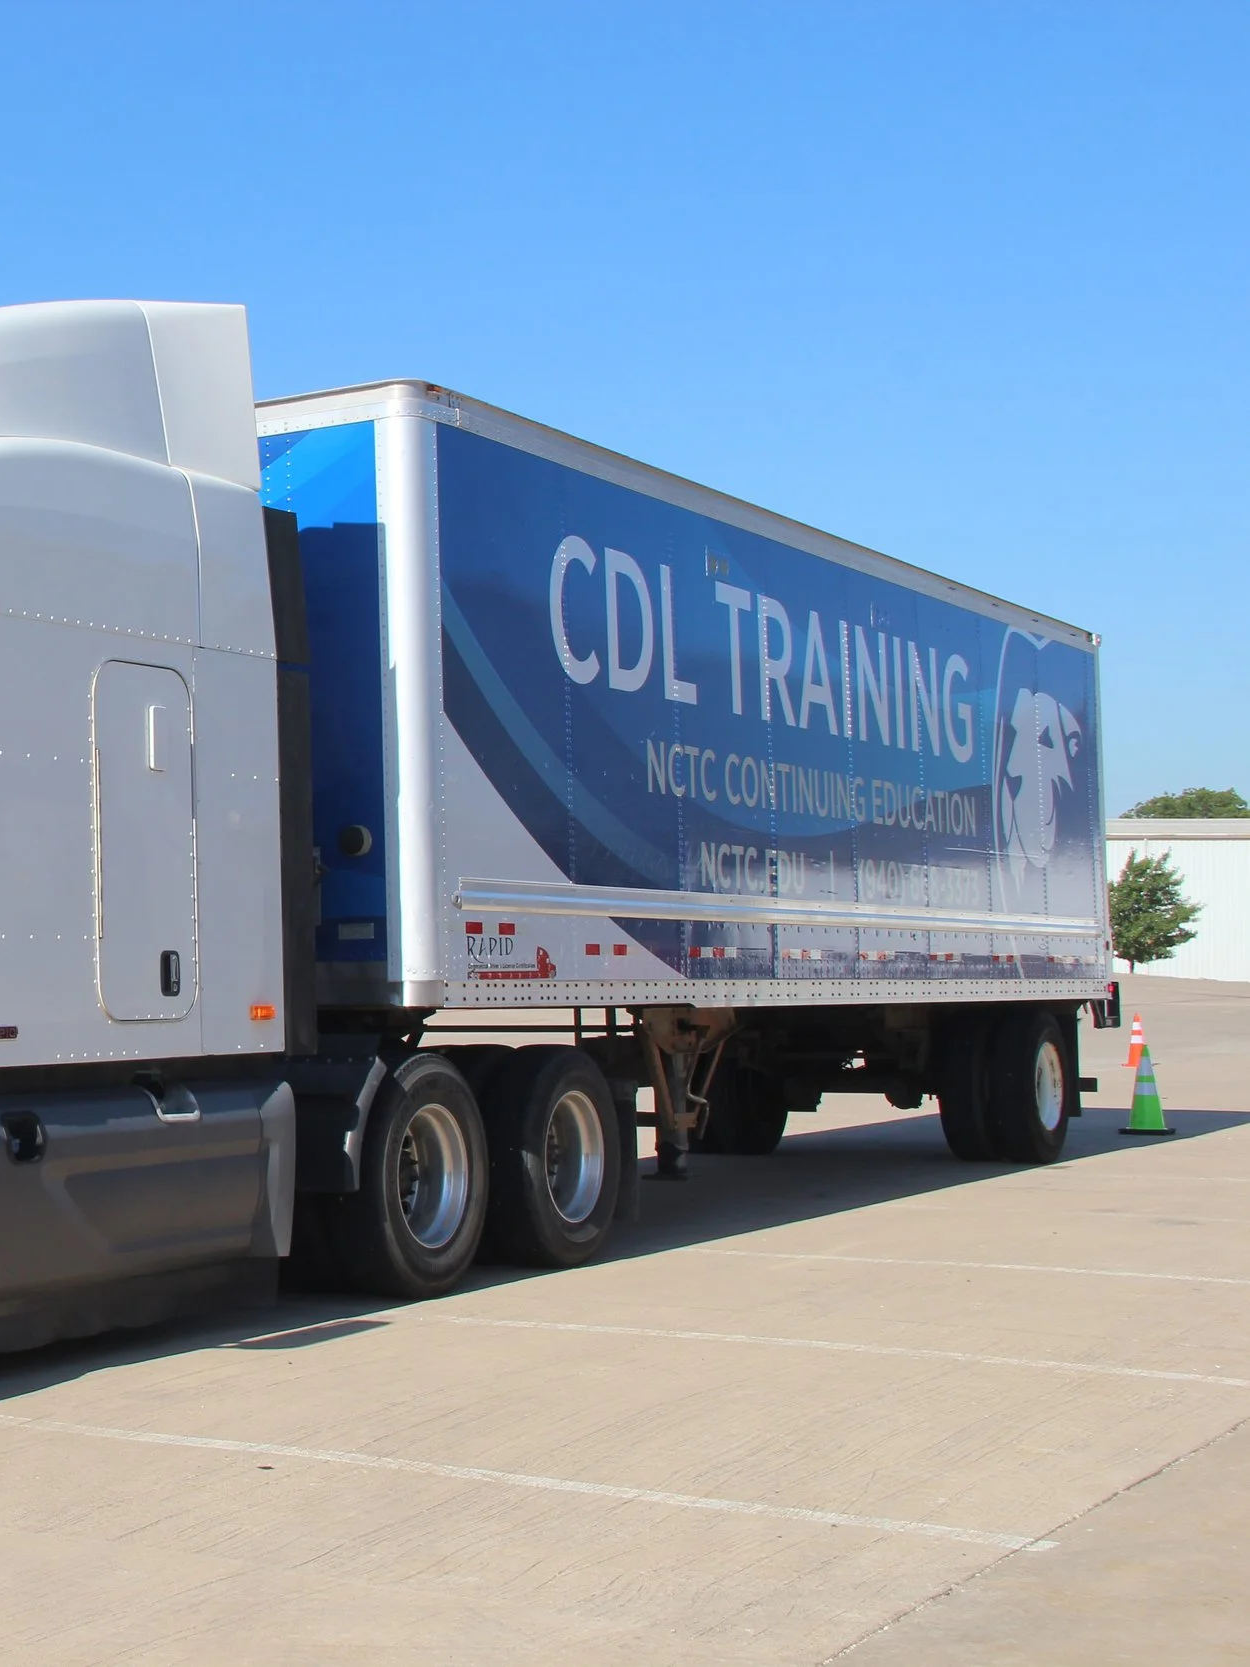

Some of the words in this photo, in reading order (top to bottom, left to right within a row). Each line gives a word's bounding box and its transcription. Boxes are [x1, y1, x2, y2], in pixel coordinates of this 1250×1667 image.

[550, 535, 698, 705] CDL
[714, 580, 974, 763] TRAINING
[647, 739, 717, 801] NCTC
[724, 753, 867, 823] CONTINUING
[872, 778, 977, 838] EDUCATION
[467, 935, 514, 963] RAPID
